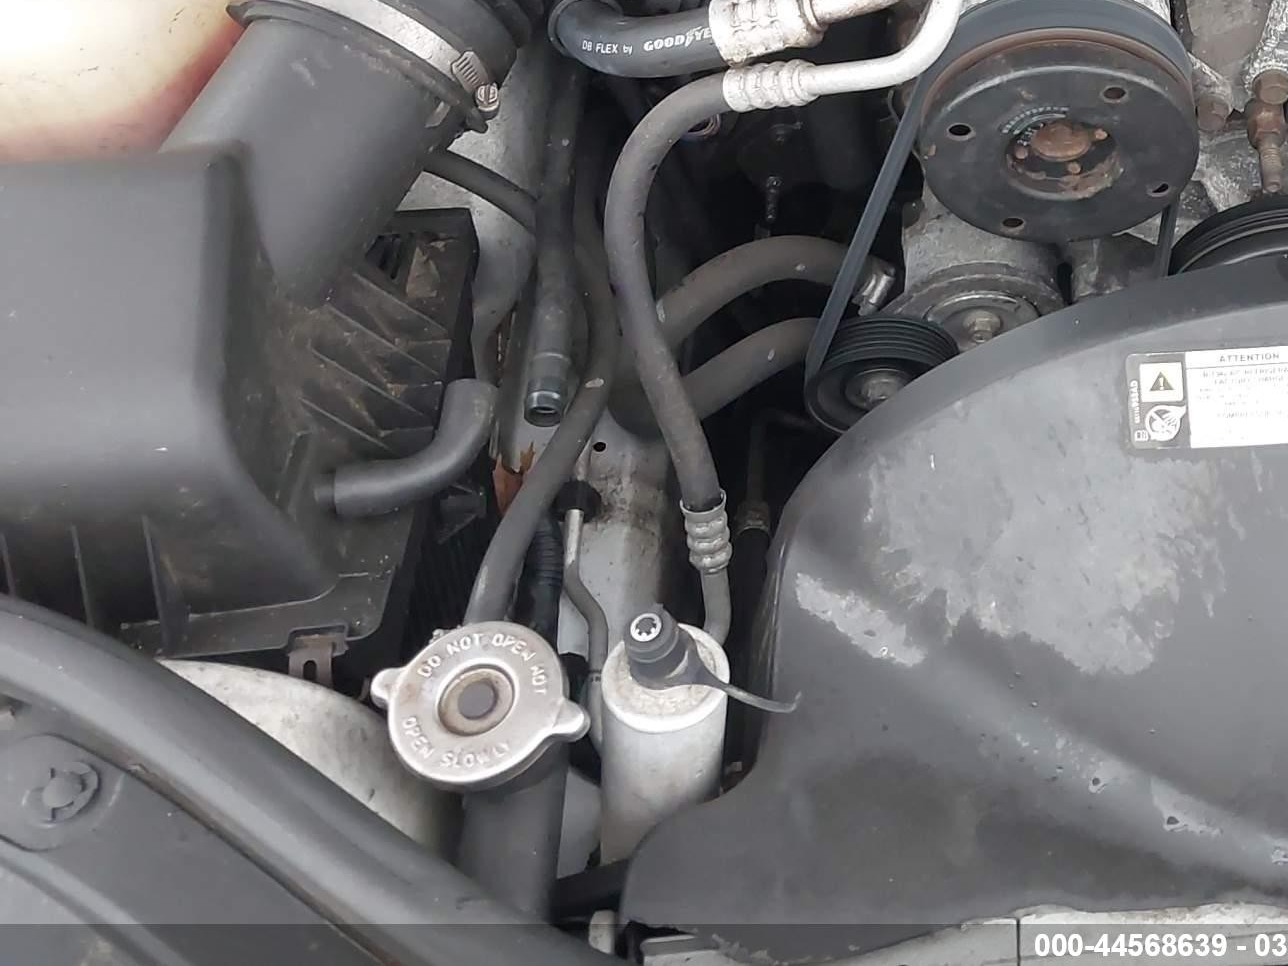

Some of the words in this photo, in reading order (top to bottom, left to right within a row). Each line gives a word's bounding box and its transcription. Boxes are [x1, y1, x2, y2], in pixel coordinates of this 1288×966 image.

[595, 42, 619, 54] FLEX
[1218, 351, 1280, 364] ATTENTION
[417, 655, 441, 677] DO
[446, 633, 482, 655] NOT
[491, 633, 537, 661] OPEN
[402, 717, 434, 759] OPEN
[440, 741, 511, 768] SLOWLY
